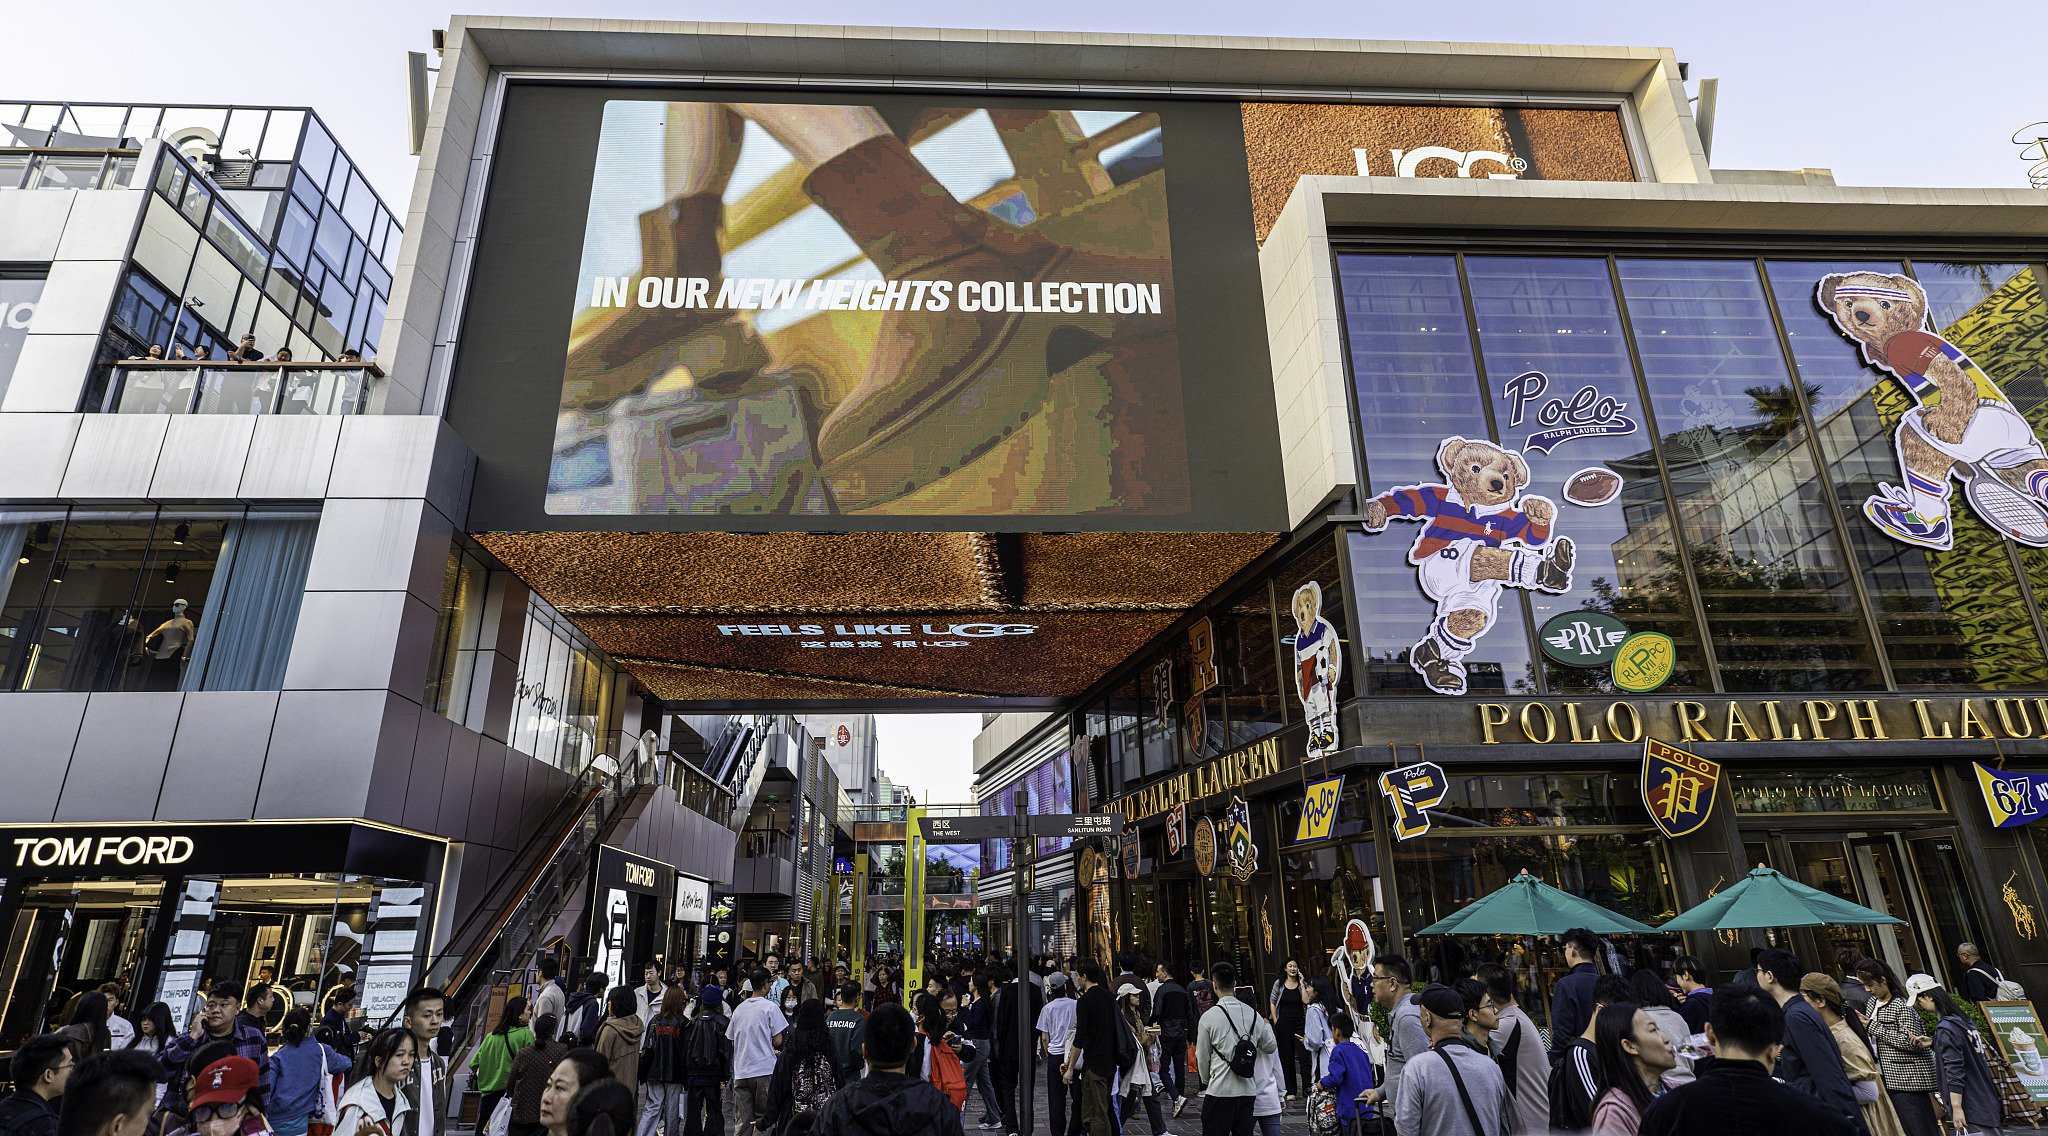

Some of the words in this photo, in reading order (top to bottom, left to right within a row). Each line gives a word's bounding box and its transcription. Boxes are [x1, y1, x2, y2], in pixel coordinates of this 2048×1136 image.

[591, 276, 627, 309] IN
[637, 276, 709, 309] OUR
[714, 277, 799, 311] NEW
[798, 279, 950, 312] HEIGHTS
[957, 280, 1161, 314] COLLECTION
[1503, 370, 1627, 427] Polo
[1543, 429, 1571, 440] RALPH
[717, 624, 824, 636] FEELS
[834, 624, 911, 636] LIKE
[922, 622, 1038, 638] UGG
[1478, 701, 1643, 744] POLO
[1675, 700, 1889, 742] RALPH
[1660, 747, 1709, 772] POLO
[1139, 772, 1192, 819] RALPH
[1197, 736, 1280, 799] LAUREN
[1404, 767, 1426, 779] Polo
[1741, 786, 1786, 798] POLO
[1795, 785, 1852, 798] RALPH
[1859, 785, 1928, 797] LAUREN
[1991, 777, 2038, 815] 67
[933, 820, 950, 829] 西区
[1074, 816, 1111, 826] 三里屯路
[1303, 789, 1335, 836] Polo
[1166, 802, 1187, 856] 67
[13, 837, 90, 867] TOM
[94, 836, 194, 865] FORD
[625, 862, 639, 885] TOM
[639, 865, 655, 888] FORD
[163, 990, 176, 999] TOM
[176, 988, 191, 998] FORD
[366, 981, 384, 990] TOM
[384, 980, 407, 989] FORD
[371, 995, 396, 1003] BLACK
